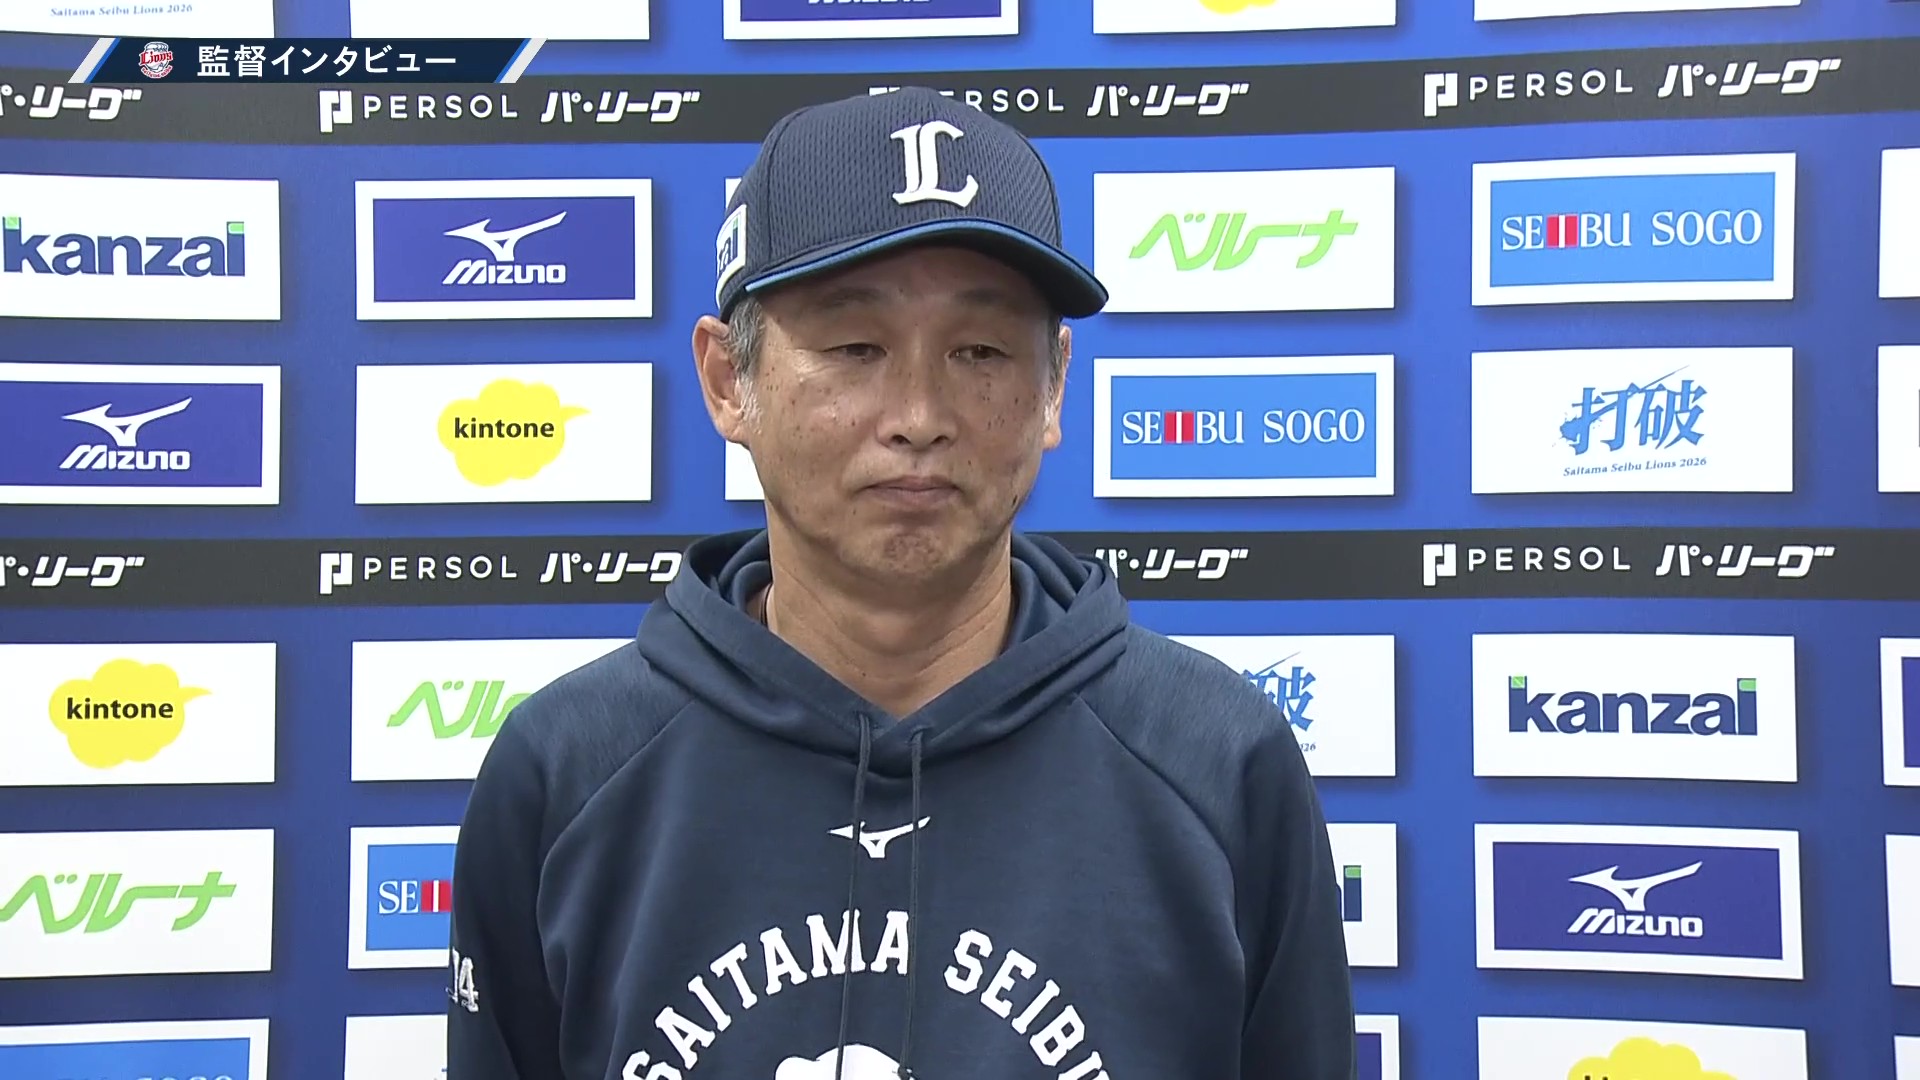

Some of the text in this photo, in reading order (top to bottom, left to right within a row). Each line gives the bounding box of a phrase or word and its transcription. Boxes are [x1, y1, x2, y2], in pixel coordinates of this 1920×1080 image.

[939, 88, 1065, 113] RSOL
[1468, 69, 1633, 101] PERSOL
[363, 95, 518, 119] PERSOL
[891, 120, 979, 208] L
[2, 216, 246, 278] kanzai
[1130, 210, 1358, 271] ベルーナ
[1502, 208, 1763, 250] SEIBU SOGO
[453, 417, 556, 440] kintone
[1122, 408, 1365, 444] SEIBU SOGO
[1560, 378, 1708, 456] 打破
[1563, 456, 1707, 477] Saitama Seibu Lions 2026
[363, 556, 518, 579] PERSOL
[1468, 546, 1631, 572] PERSOL
[66, 696, 174, 720] kintone
[386, 681, 533, 739] ベル
[1240, 667, 1316, 731] 破
[1508, 676, 1757, 736] kanzai
[0, 872, 237, 934] ベルーナ
[378, 880, 441, 914] SEI
[622, 909, 909, 1080] SAITAMA
